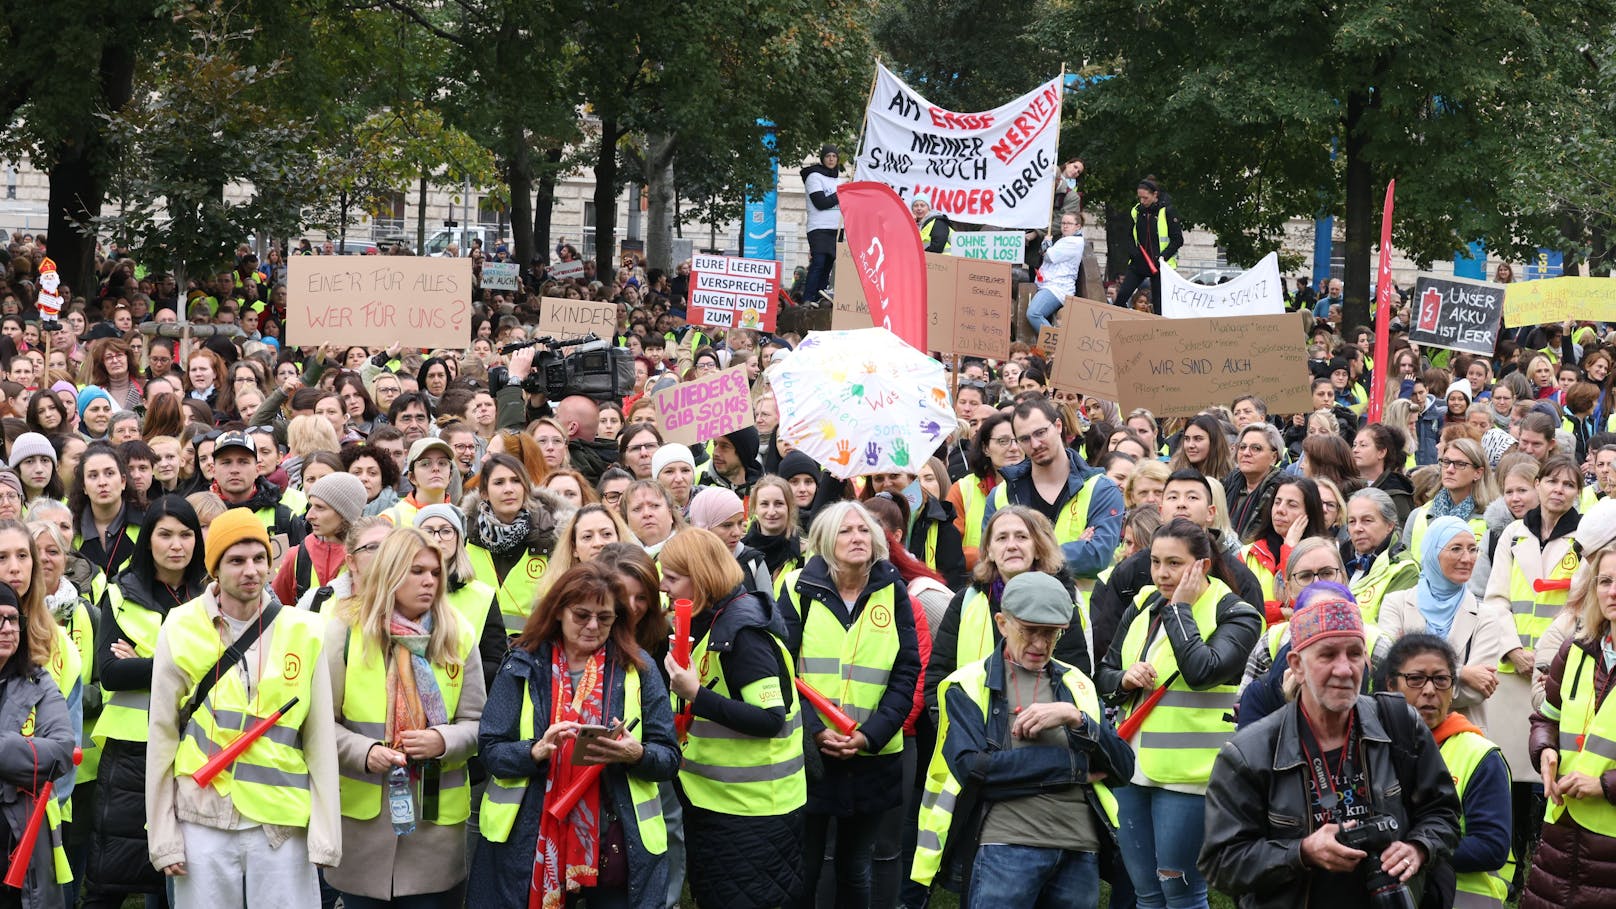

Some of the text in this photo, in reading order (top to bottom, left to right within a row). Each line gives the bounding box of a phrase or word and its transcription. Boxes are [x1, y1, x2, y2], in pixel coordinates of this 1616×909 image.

[888, 90, 920, 121] AM
[990, 84, 1059, 163] NERVEN
[910, 131, 983, 157] MEINER
[868, 147, 986, 180] SIND NOCH
[998, 149, 1049, 208] ÜBRIG
[956, 235, 1022, 248] OHNE MOOS
[964, 247, 1018, 261] NIX LOS!
[695, 258, 771, 275] EURE LEEREN
[373, 267, 405, 292] FÜR
[413, 271, 458, 293] ALLES
[693, 293, 766, 310] UNGEN SIND
[1450, 287, 1495, 310] UNSER
[306, 299, 466, 331] WER FÜR UNS?
[706, 311, 731, 324] ZUM
[1090, 307, 1112, 330] VO
[1449, 309, 1486, 323] AKKU
[1439, 325, 1492, 345] IST LEER
[1149, 359, 1175, 375] WIR
[1180, 357, 1213, 375] SIND
[1221, 358, 1251, 374] AUCH
[865, 390, 900, 412] Was
[665, 408, 695, 431] GIB
[1313, 757, 1328, 790] Canon
